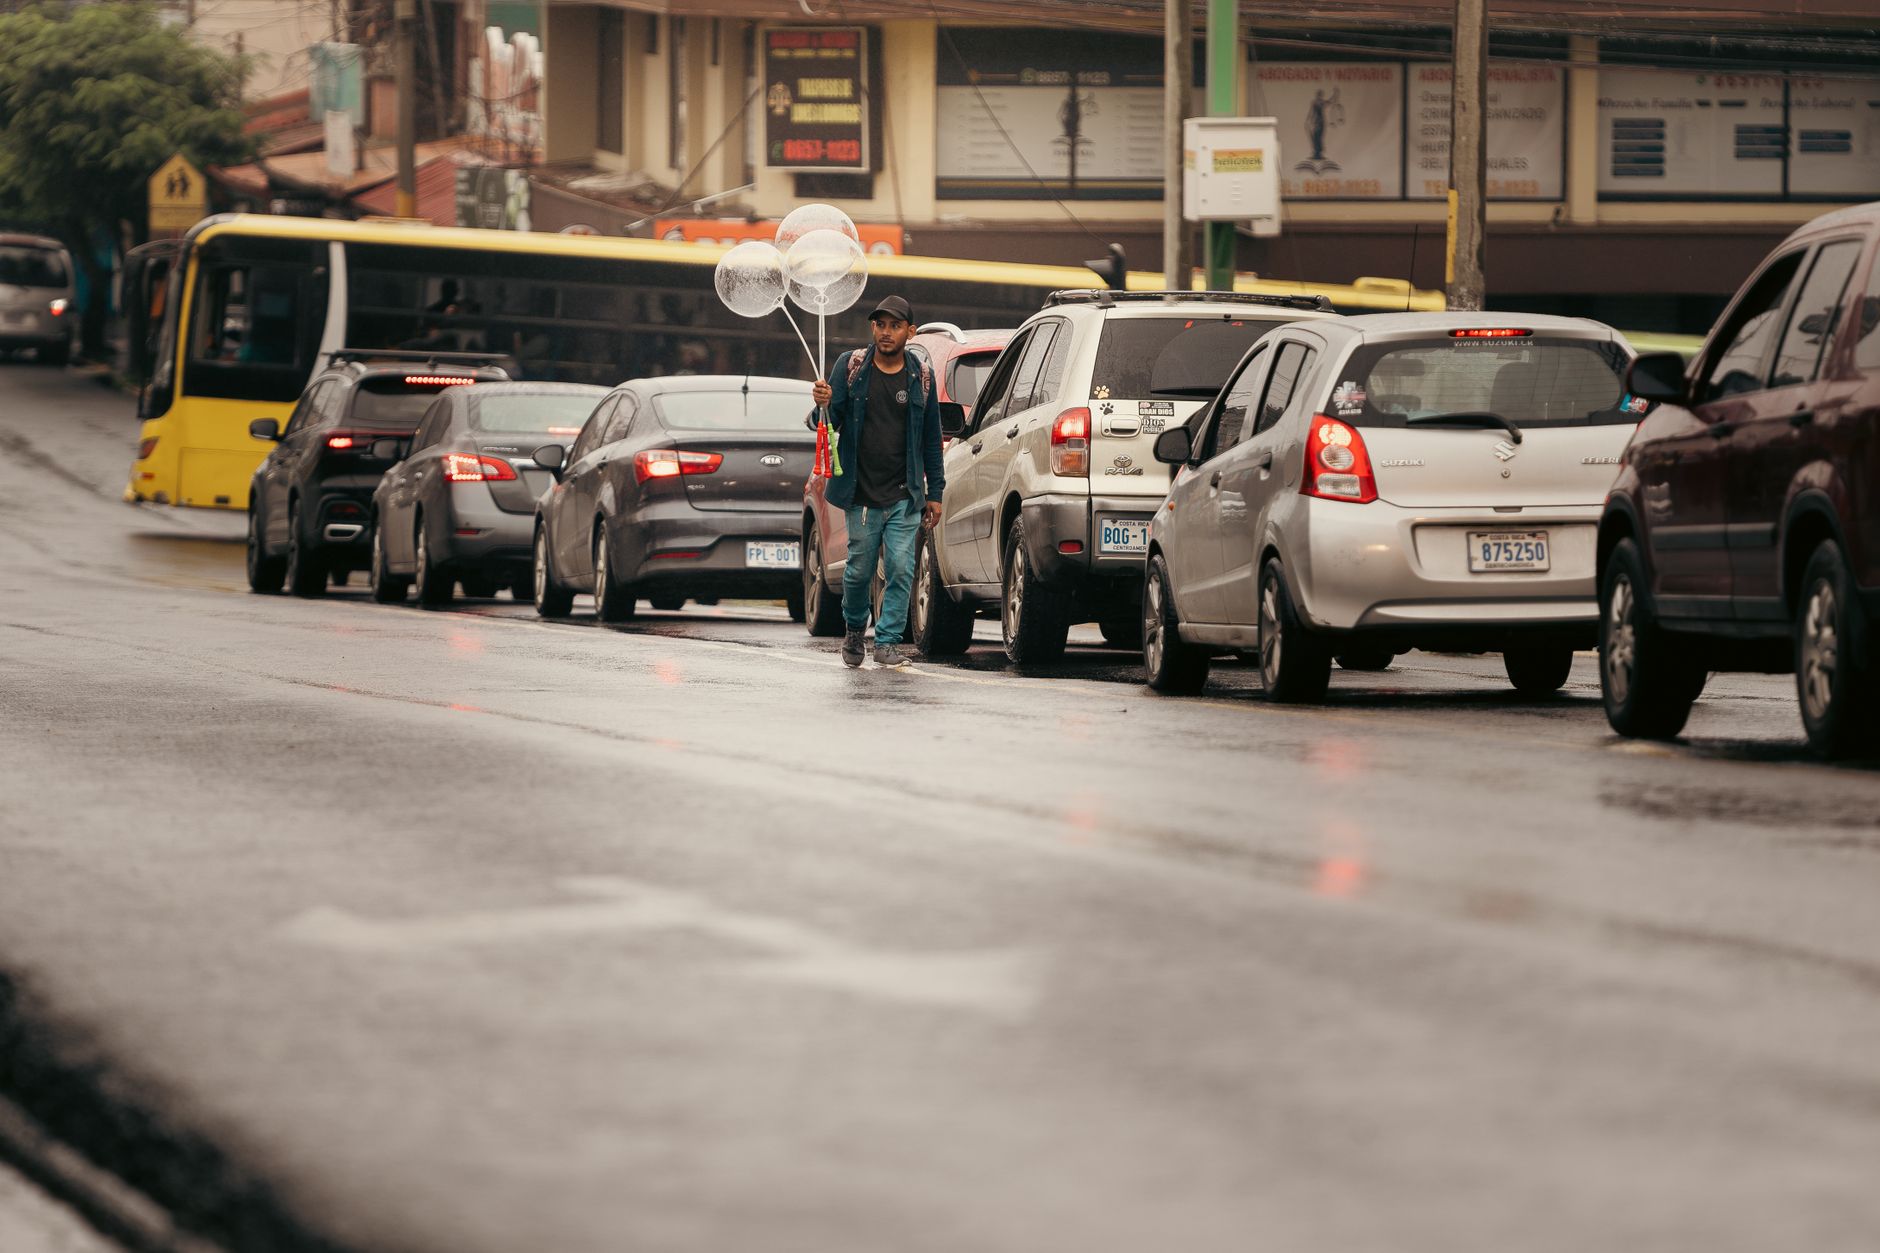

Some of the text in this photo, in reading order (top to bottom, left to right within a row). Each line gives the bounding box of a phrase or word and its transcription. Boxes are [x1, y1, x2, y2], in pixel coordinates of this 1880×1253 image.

[1381, 458, 1425, 467] SUZUKI
[1581, 456, 1622, 465] CELERI
[1105, 467, 1144, 476] RAV4
[1104, 527, 1147, 545] BQG-1
[748, 547, 796, 561] FPL-001
[1482, 542, 1545, 562] 875250
